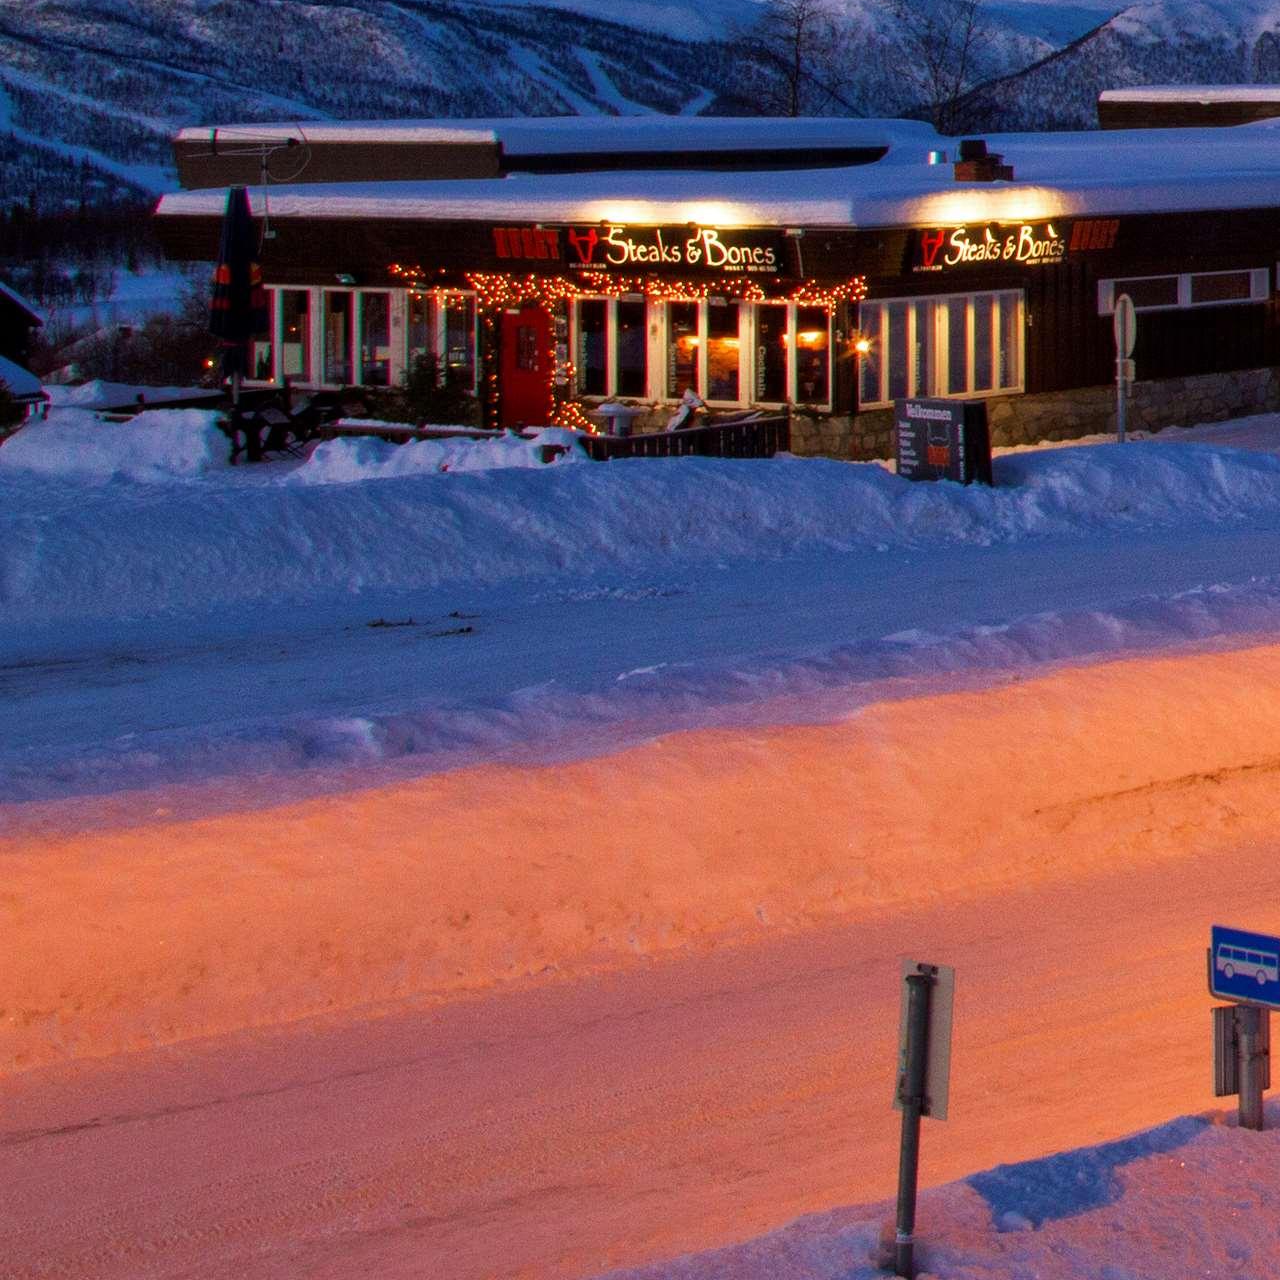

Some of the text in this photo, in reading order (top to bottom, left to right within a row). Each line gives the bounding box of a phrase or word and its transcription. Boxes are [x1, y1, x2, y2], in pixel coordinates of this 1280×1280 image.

[602, 226, 776, 266] Steaks & Bones
[945, 224, 1065, 265] Steaks & Bones
[759, 345, 767, 397] Cocktails
[906, 403, 952, 421] Velkommen
